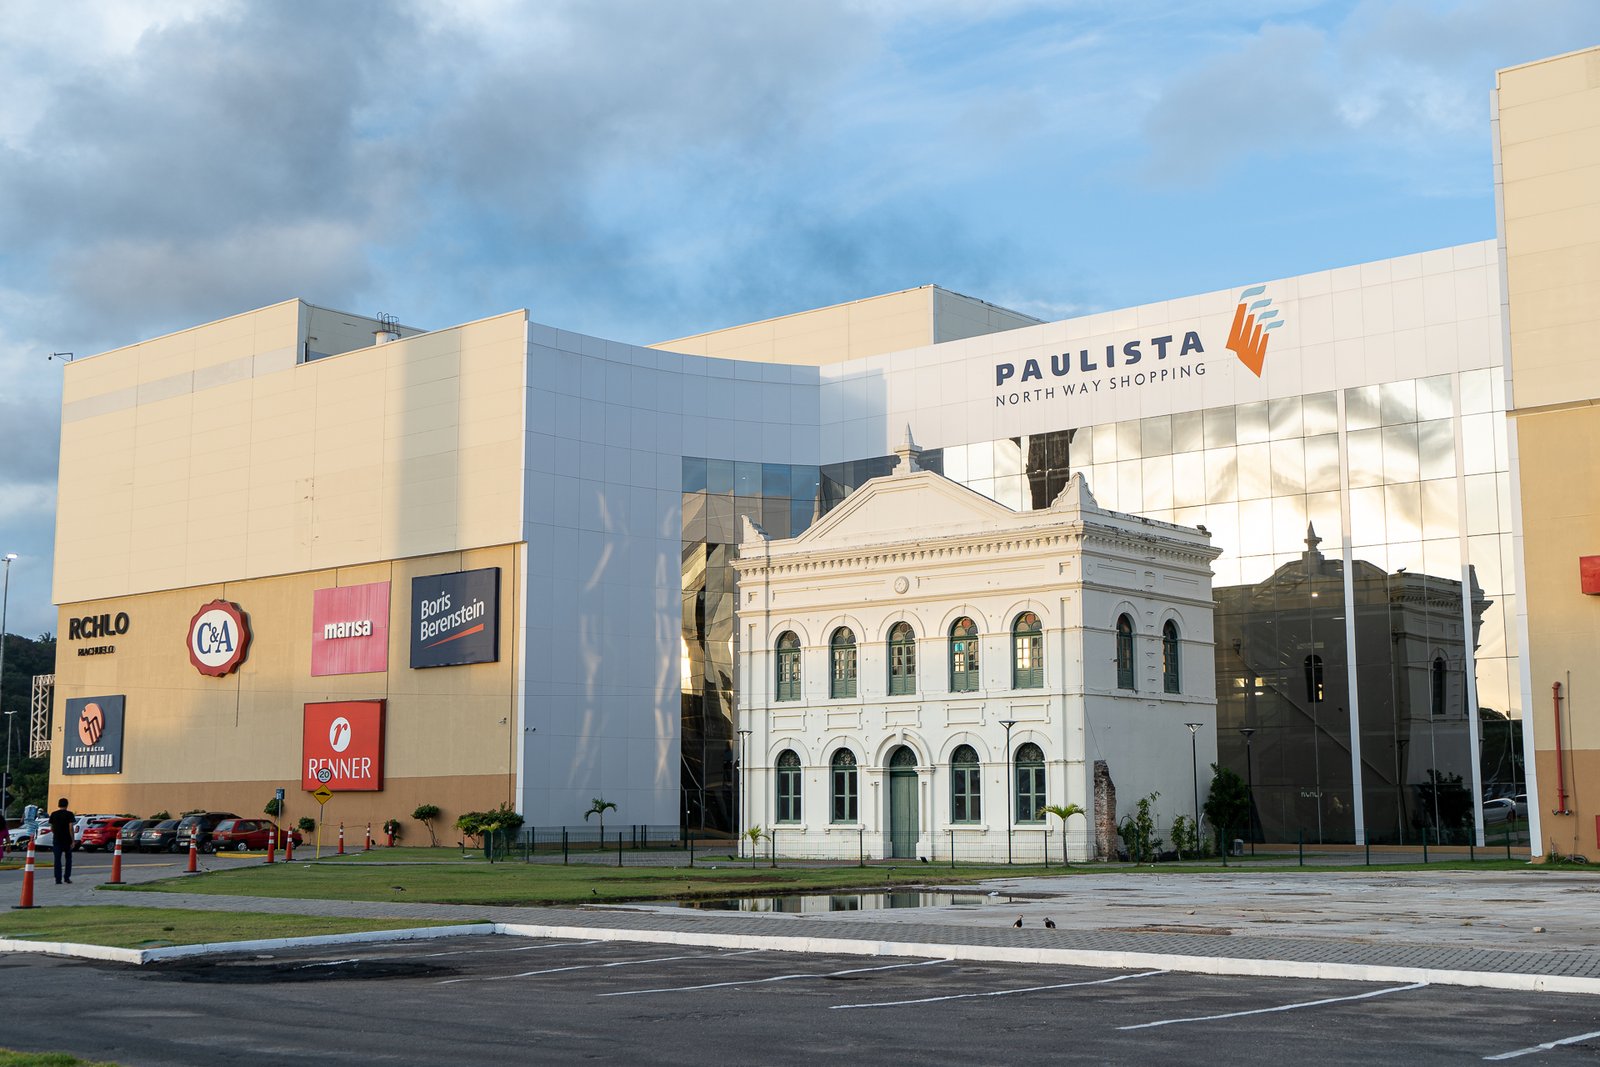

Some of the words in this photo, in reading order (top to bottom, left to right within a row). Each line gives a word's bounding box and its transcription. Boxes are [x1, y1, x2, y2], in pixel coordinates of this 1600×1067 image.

[996, 331, 1204, 386] PAULISTA
[996, 387, 1055, 407] NORTH
[1063, 379, 1102, 396] WAY
[1109, 363, 1206, 390] SHOPPING
[420, 598, 485, 641] Berenstein
[421, 591, 451, 620] Boris
[69, 612, 129, 640] RCHLO
[197, 620, 233, 654] C&A
[324, 620, 372, 640] marisa
[66, 755, 87, 768] SANTA
[89, 754, 113, 767] MARIA
[319, 770, 330, 778] 20
